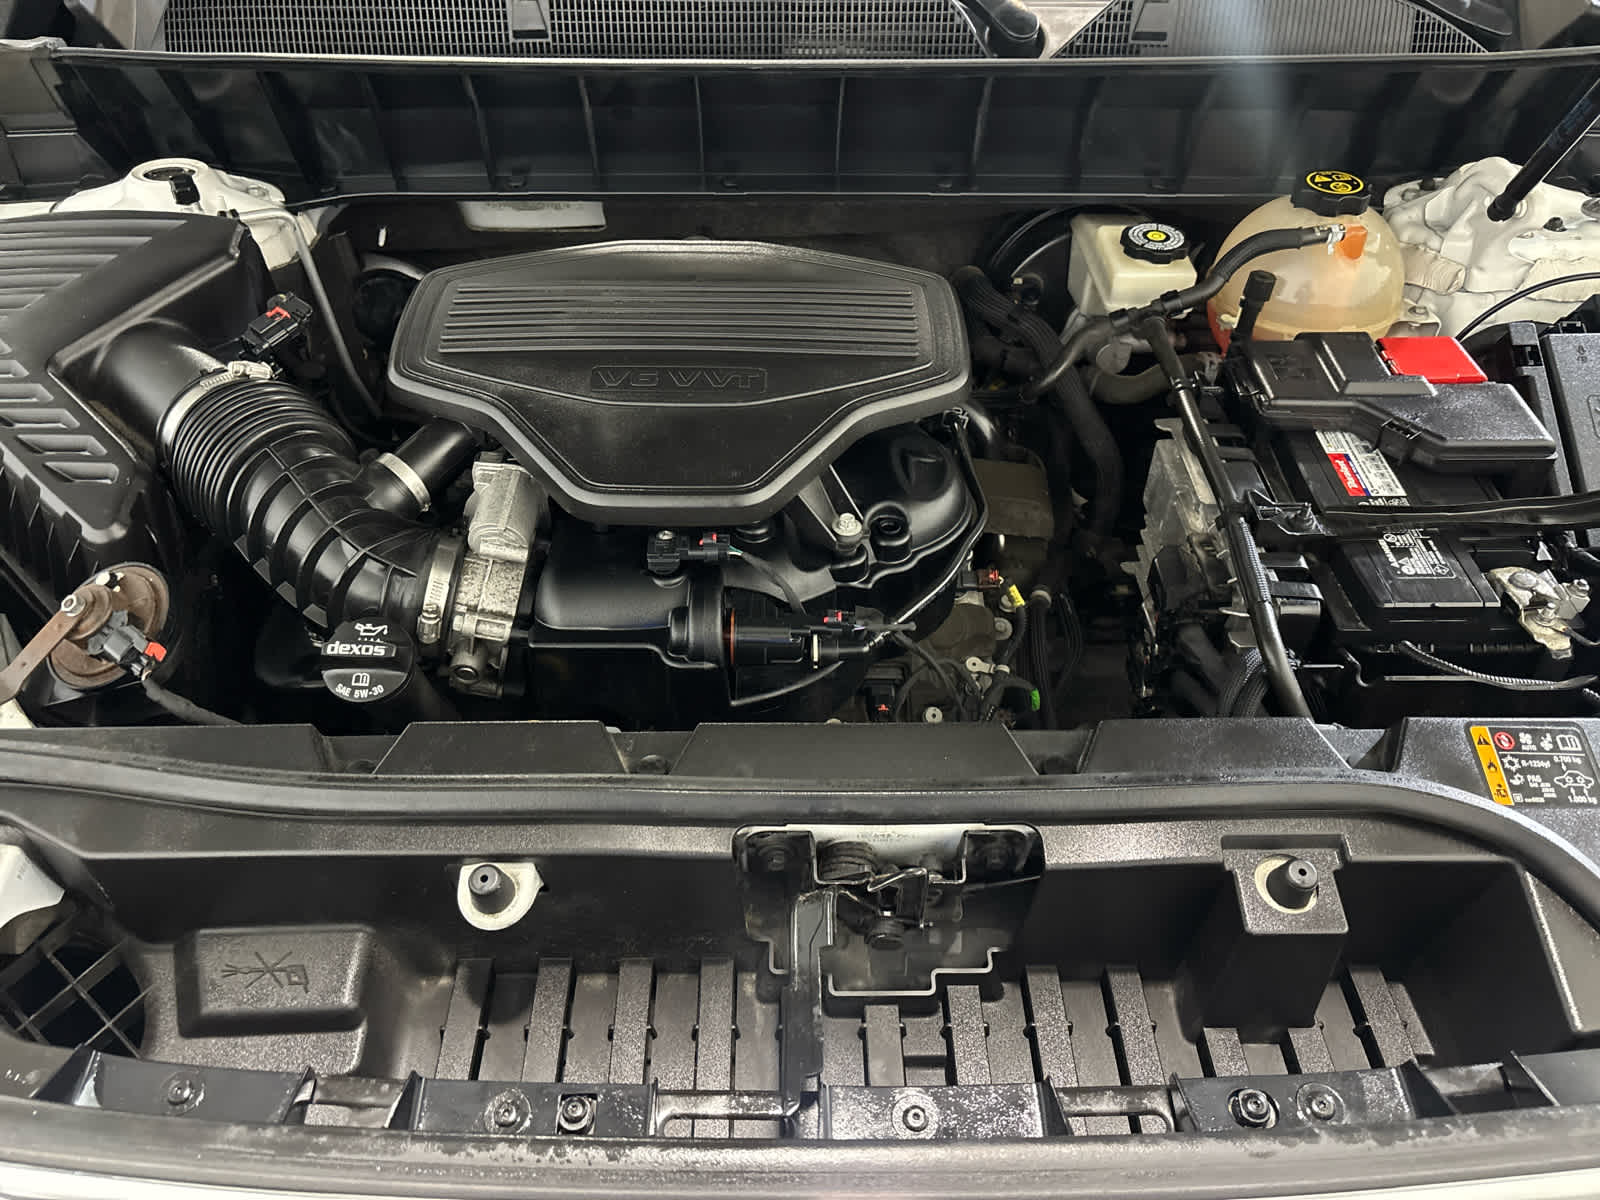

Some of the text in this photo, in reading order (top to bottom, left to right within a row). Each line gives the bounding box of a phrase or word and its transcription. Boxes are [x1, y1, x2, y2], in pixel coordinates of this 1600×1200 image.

[597, 370, 762, 388] V6 VVT
[326, 641, 388, 656] dexos
[335, 683, 385, 698] SAE 5W-30
